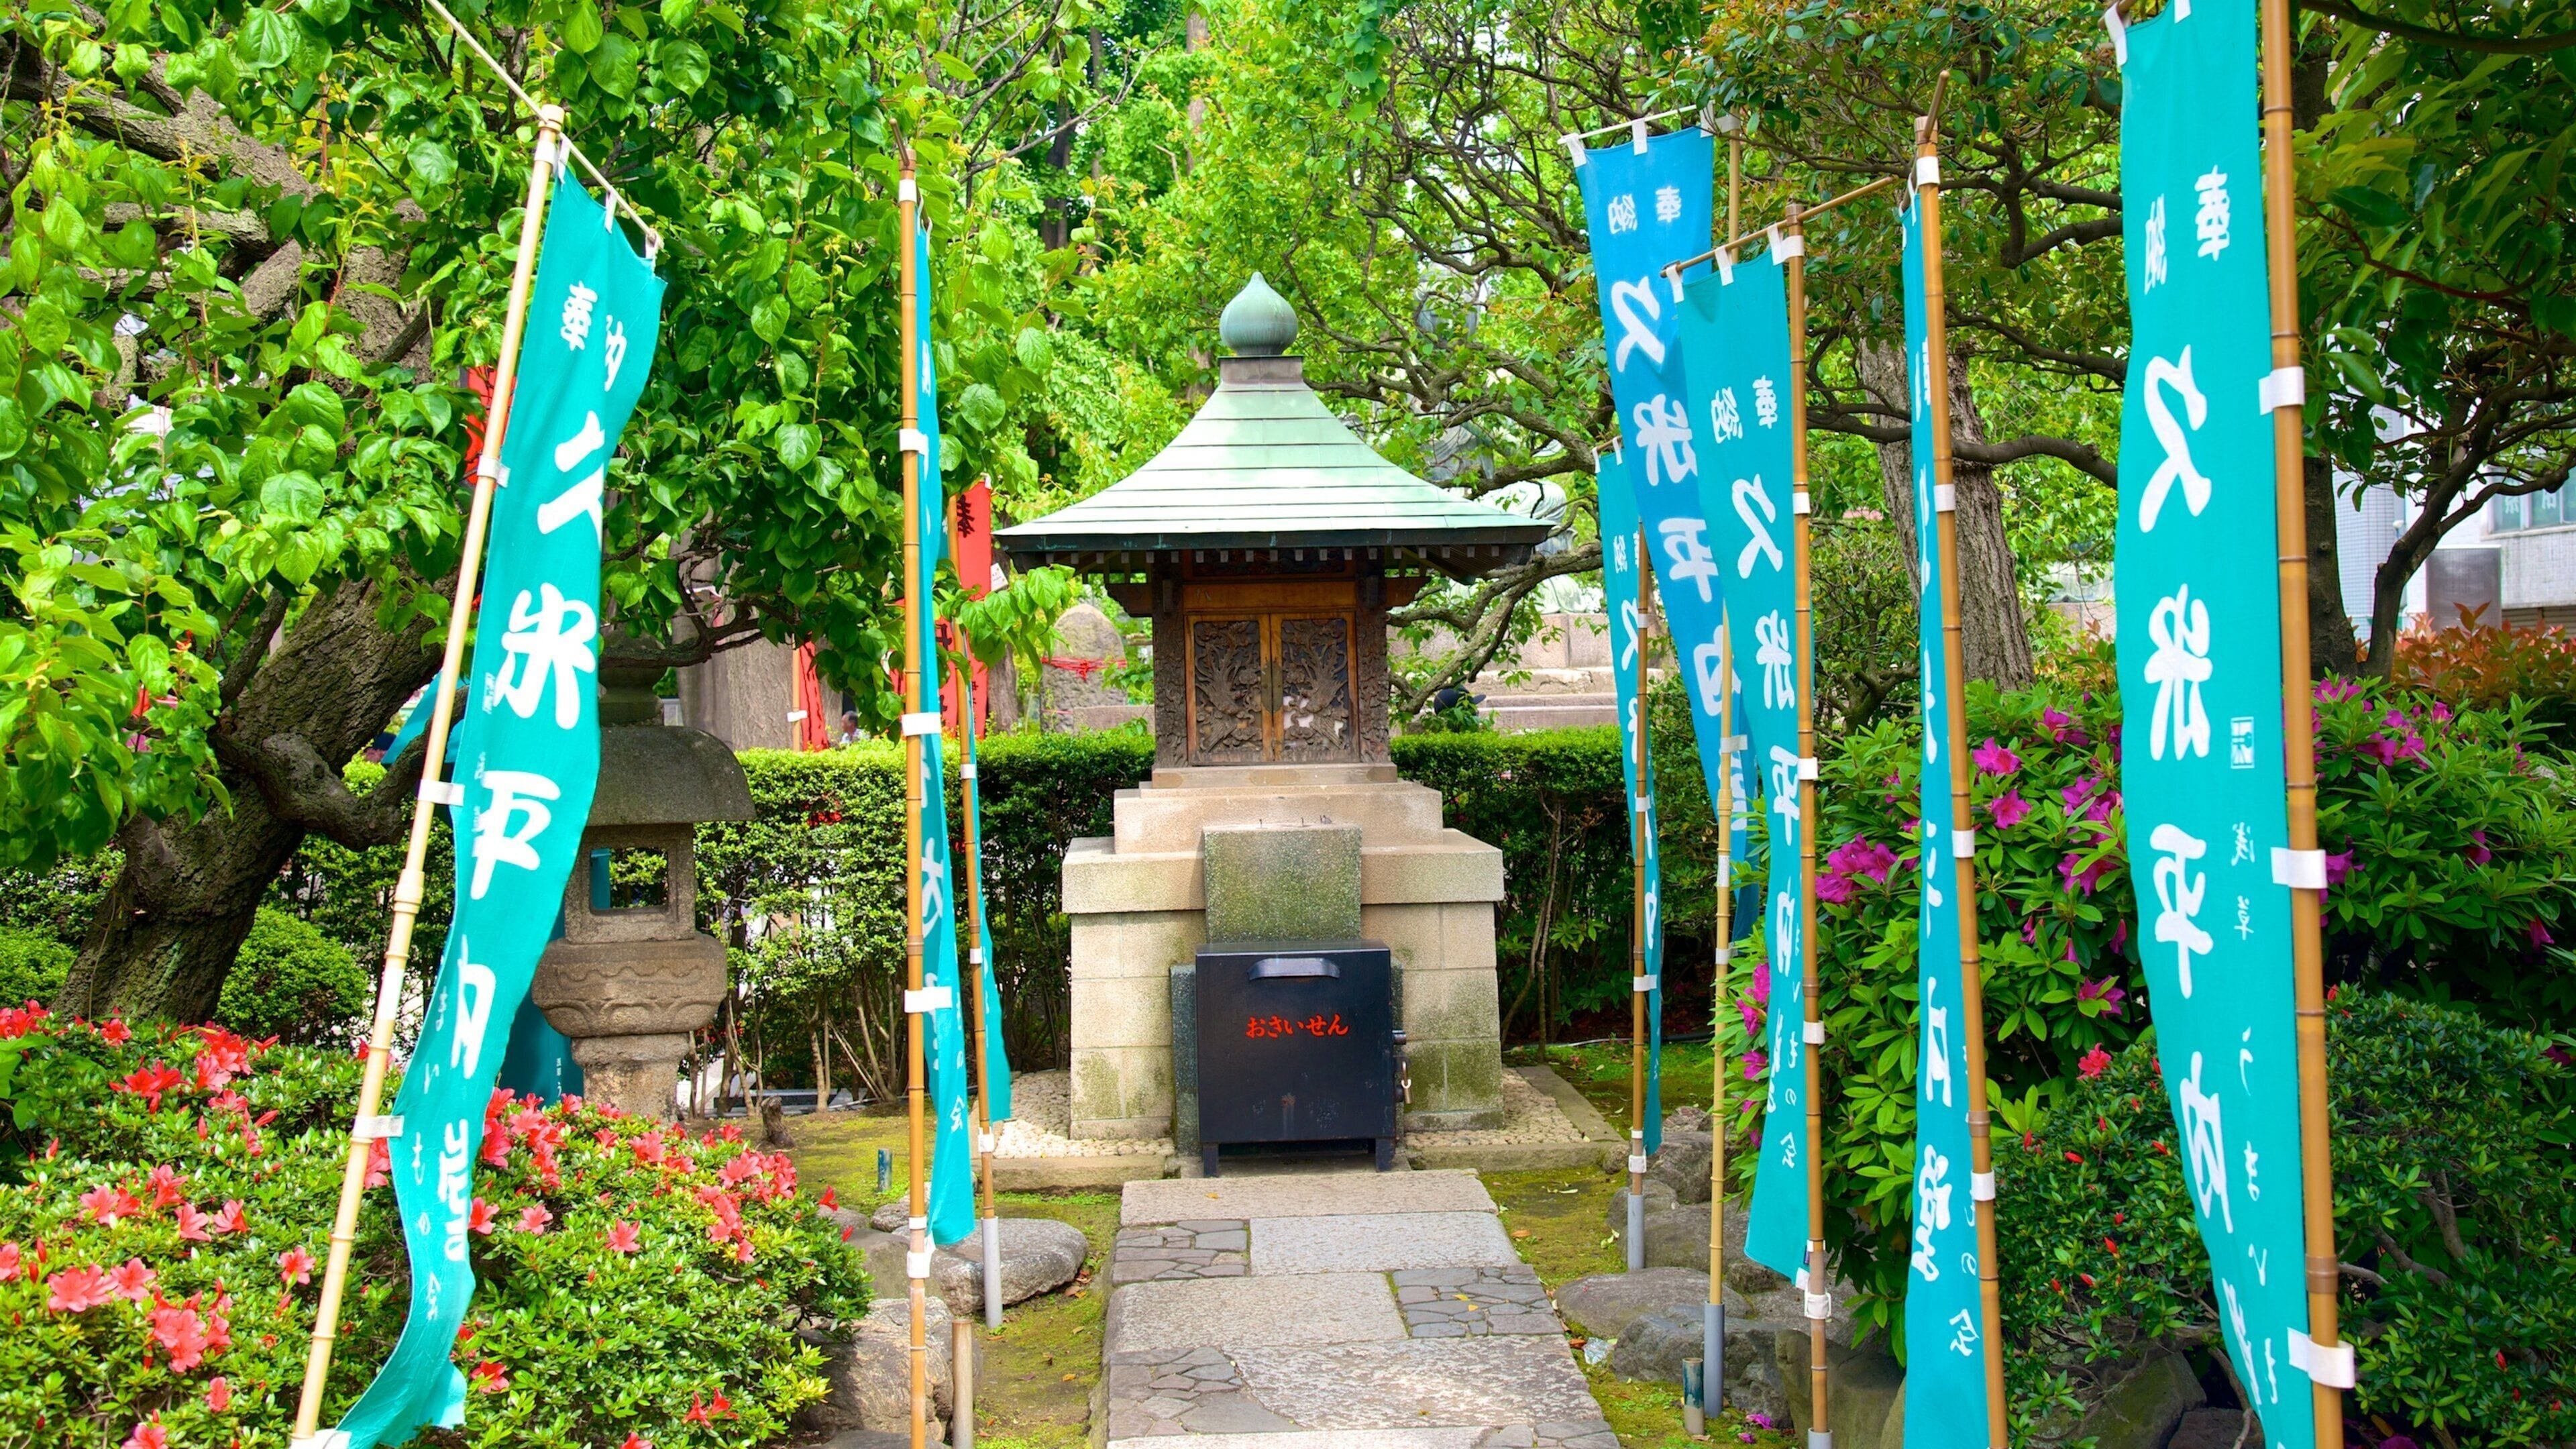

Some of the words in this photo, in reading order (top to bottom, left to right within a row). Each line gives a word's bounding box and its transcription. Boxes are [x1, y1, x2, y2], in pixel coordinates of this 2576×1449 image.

[1245, 1014, 1350, 1039] おさいせん
